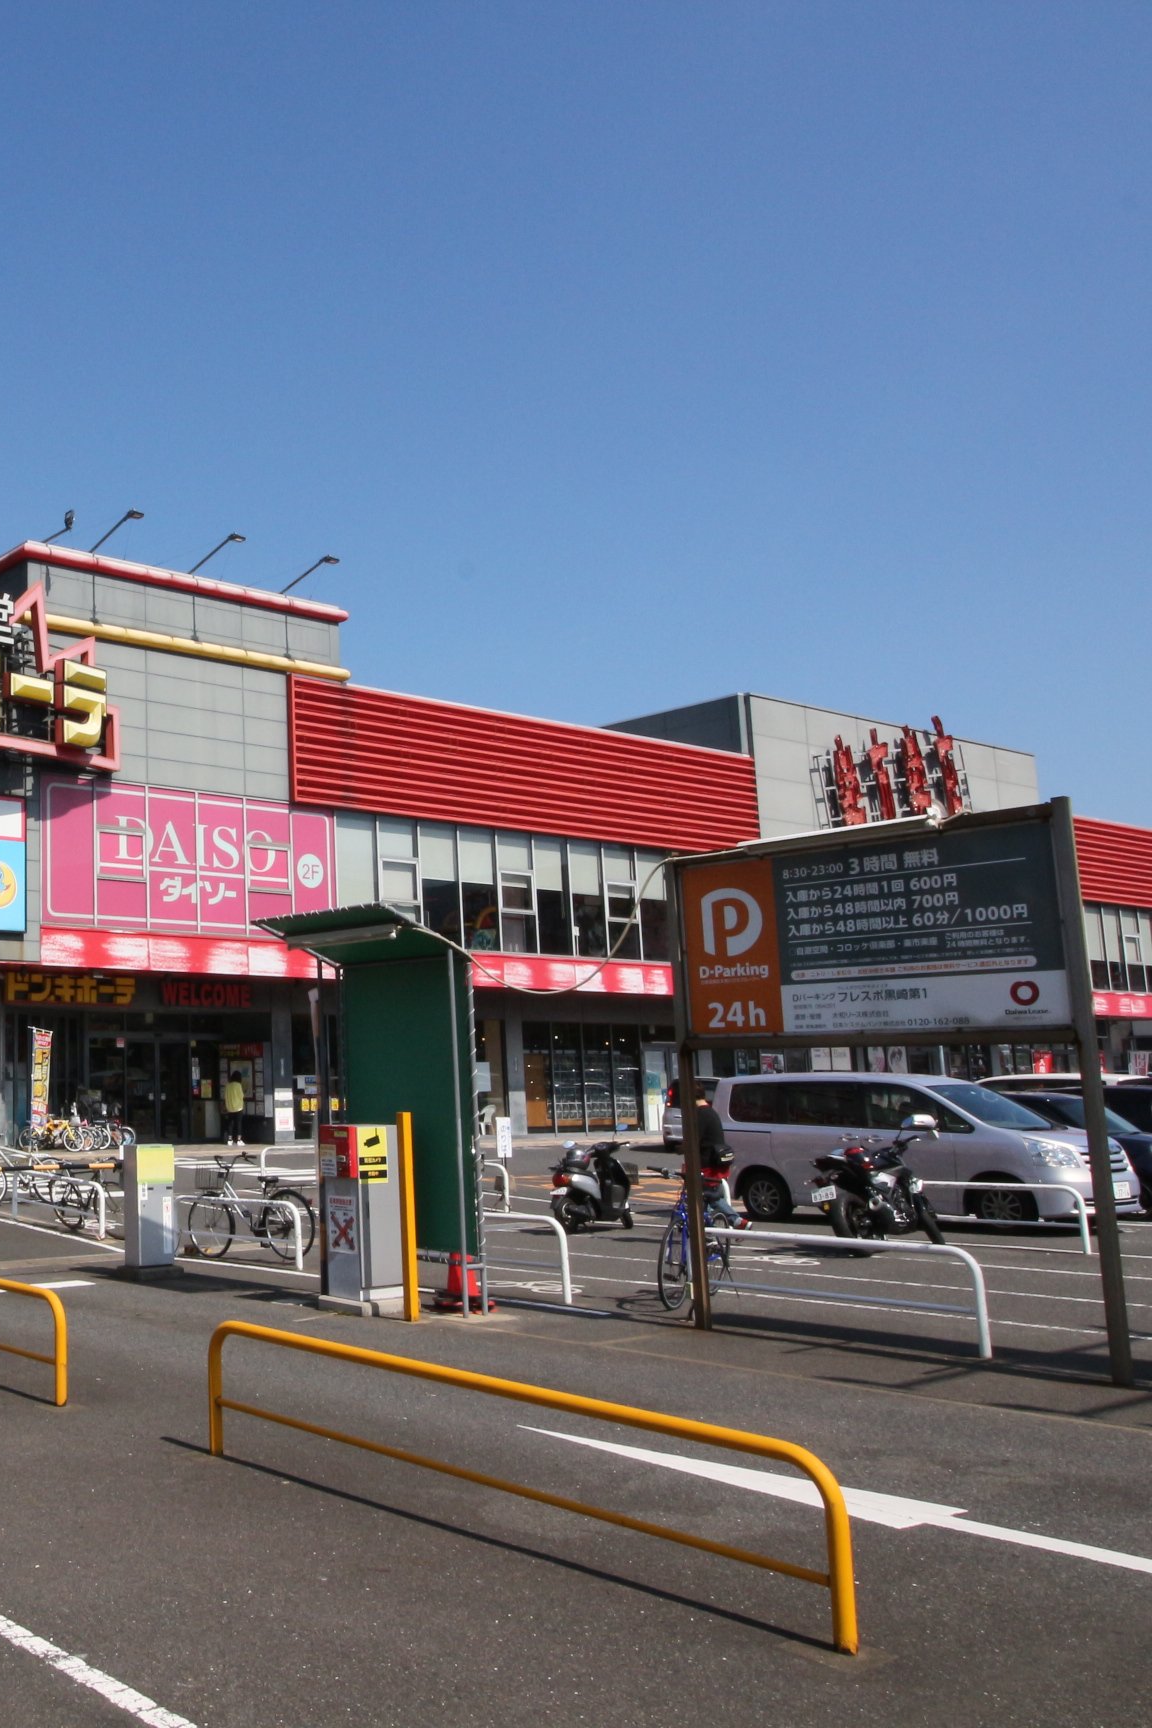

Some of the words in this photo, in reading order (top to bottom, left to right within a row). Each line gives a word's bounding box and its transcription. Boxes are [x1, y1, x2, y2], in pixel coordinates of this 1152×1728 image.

[114, 815, 276, 873] DAISO
[301, 863, 321, 880] 2F
[782, 862, 843, 880] 8:30-23:00
[848, 852, 898, 875] 3時間
[903, 847, 939, 868] 無料
[160, 876, 237, 905] ダイソー
[909, 872, 958, 893] 600円
[911, 891, 959, 910] 700円
[699, 963, 769, 979] D-Parking
[162, 982, 251, 1009] WELCOME
